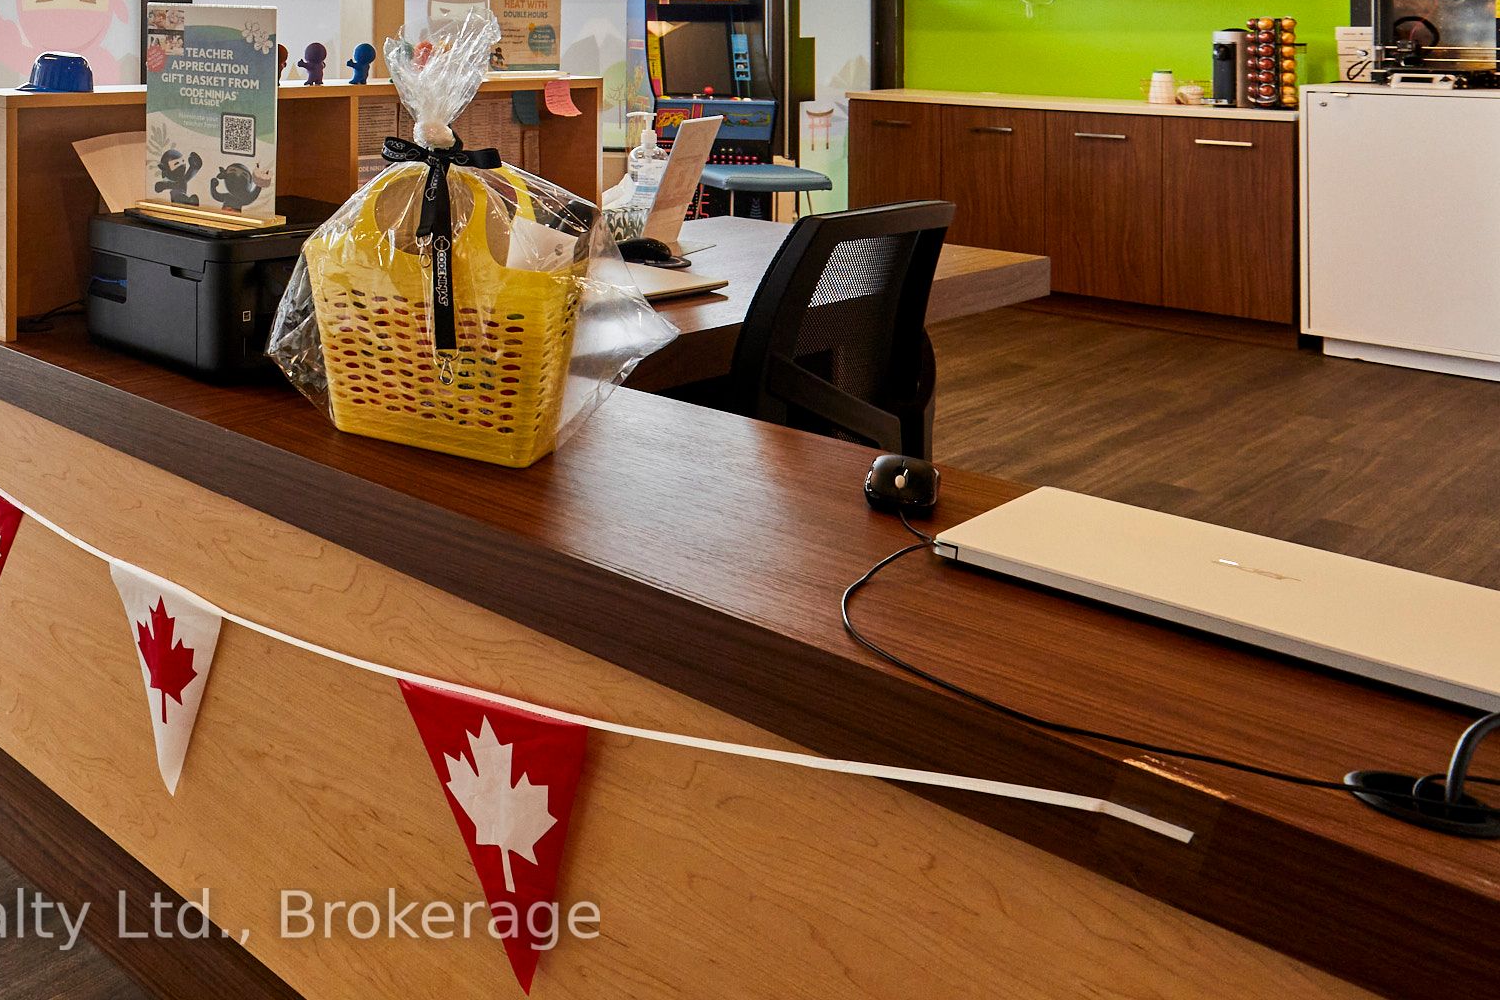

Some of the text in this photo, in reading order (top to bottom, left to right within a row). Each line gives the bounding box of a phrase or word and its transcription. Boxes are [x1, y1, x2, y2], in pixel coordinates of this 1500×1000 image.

[504, 0, 548, 9] HEAT WITH
[528, 11, 548, 19] HOURS
[185, 47, 234, 60] TEACHER
[171, 59, 249, 75] APPRECIATION
[161, 73, 260, 90] GIFT BASKET FROM
[190, 97, 220, 107] LEASIDE
